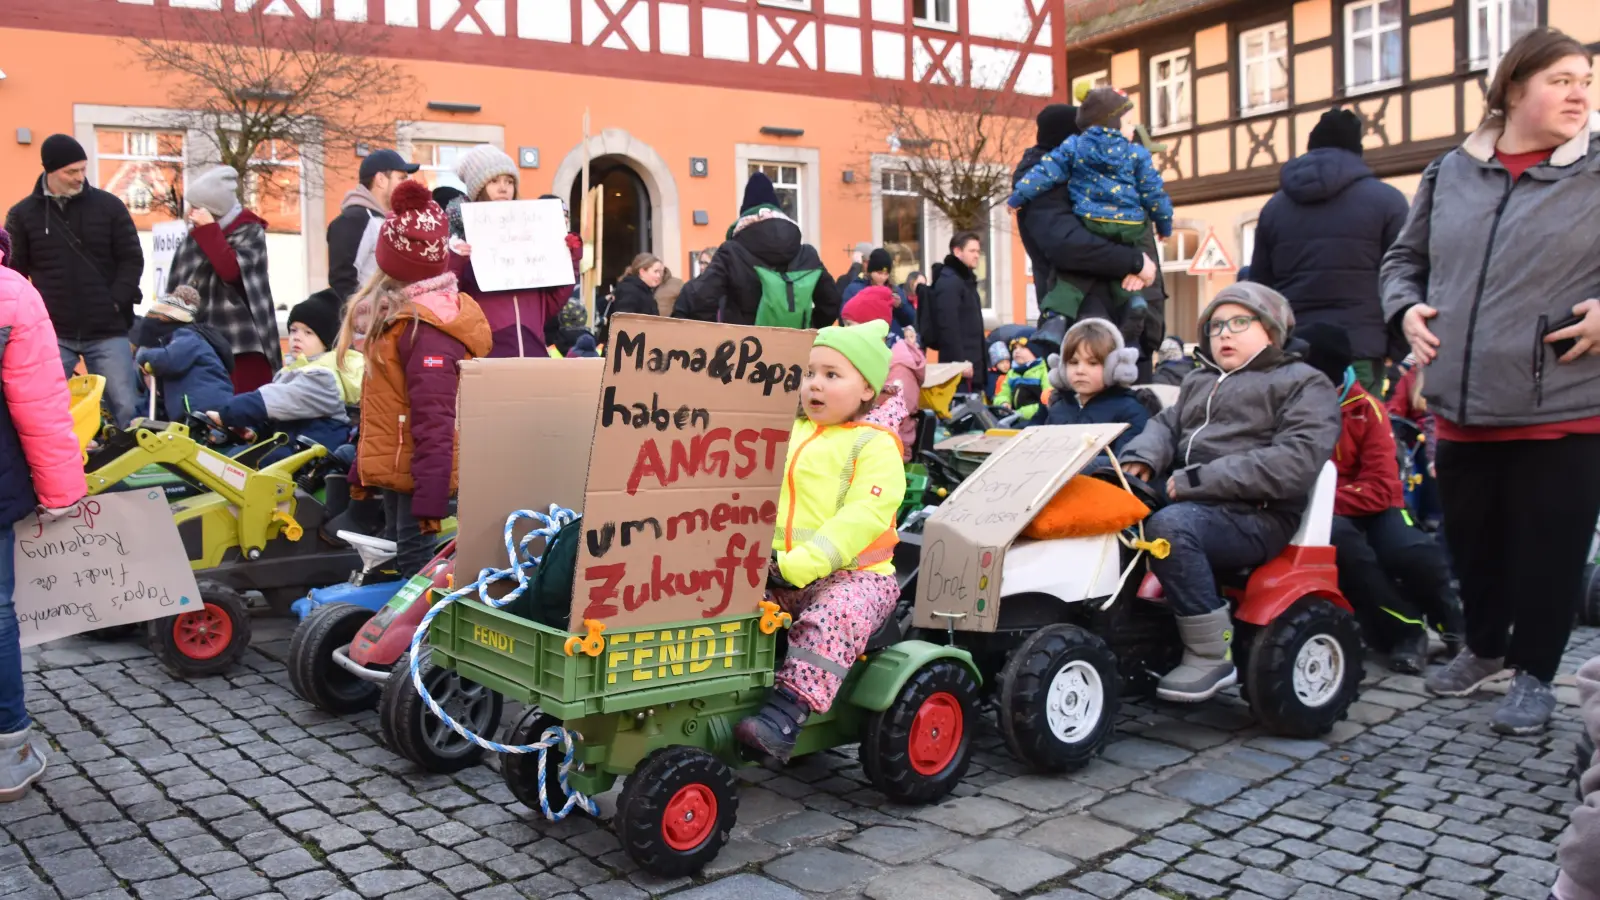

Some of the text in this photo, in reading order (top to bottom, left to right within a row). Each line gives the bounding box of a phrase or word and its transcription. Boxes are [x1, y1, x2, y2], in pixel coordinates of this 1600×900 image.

[601, 386, 710, 432] haben
[626, 427, 790, 496] ANGST
[20, 525, 130, 559] Regierung
[586, 492, 777, 558] um meine
[29, 562, 129, 591] findet die
[582, 532, 767, 619] Zukunft
[923, 539, 970, 602] Brot
[17, 580, 175, 630] Papa's Bauernho
[473, 623, 516, 654] FENDT
[607, 622, 741, 684] FENDT
